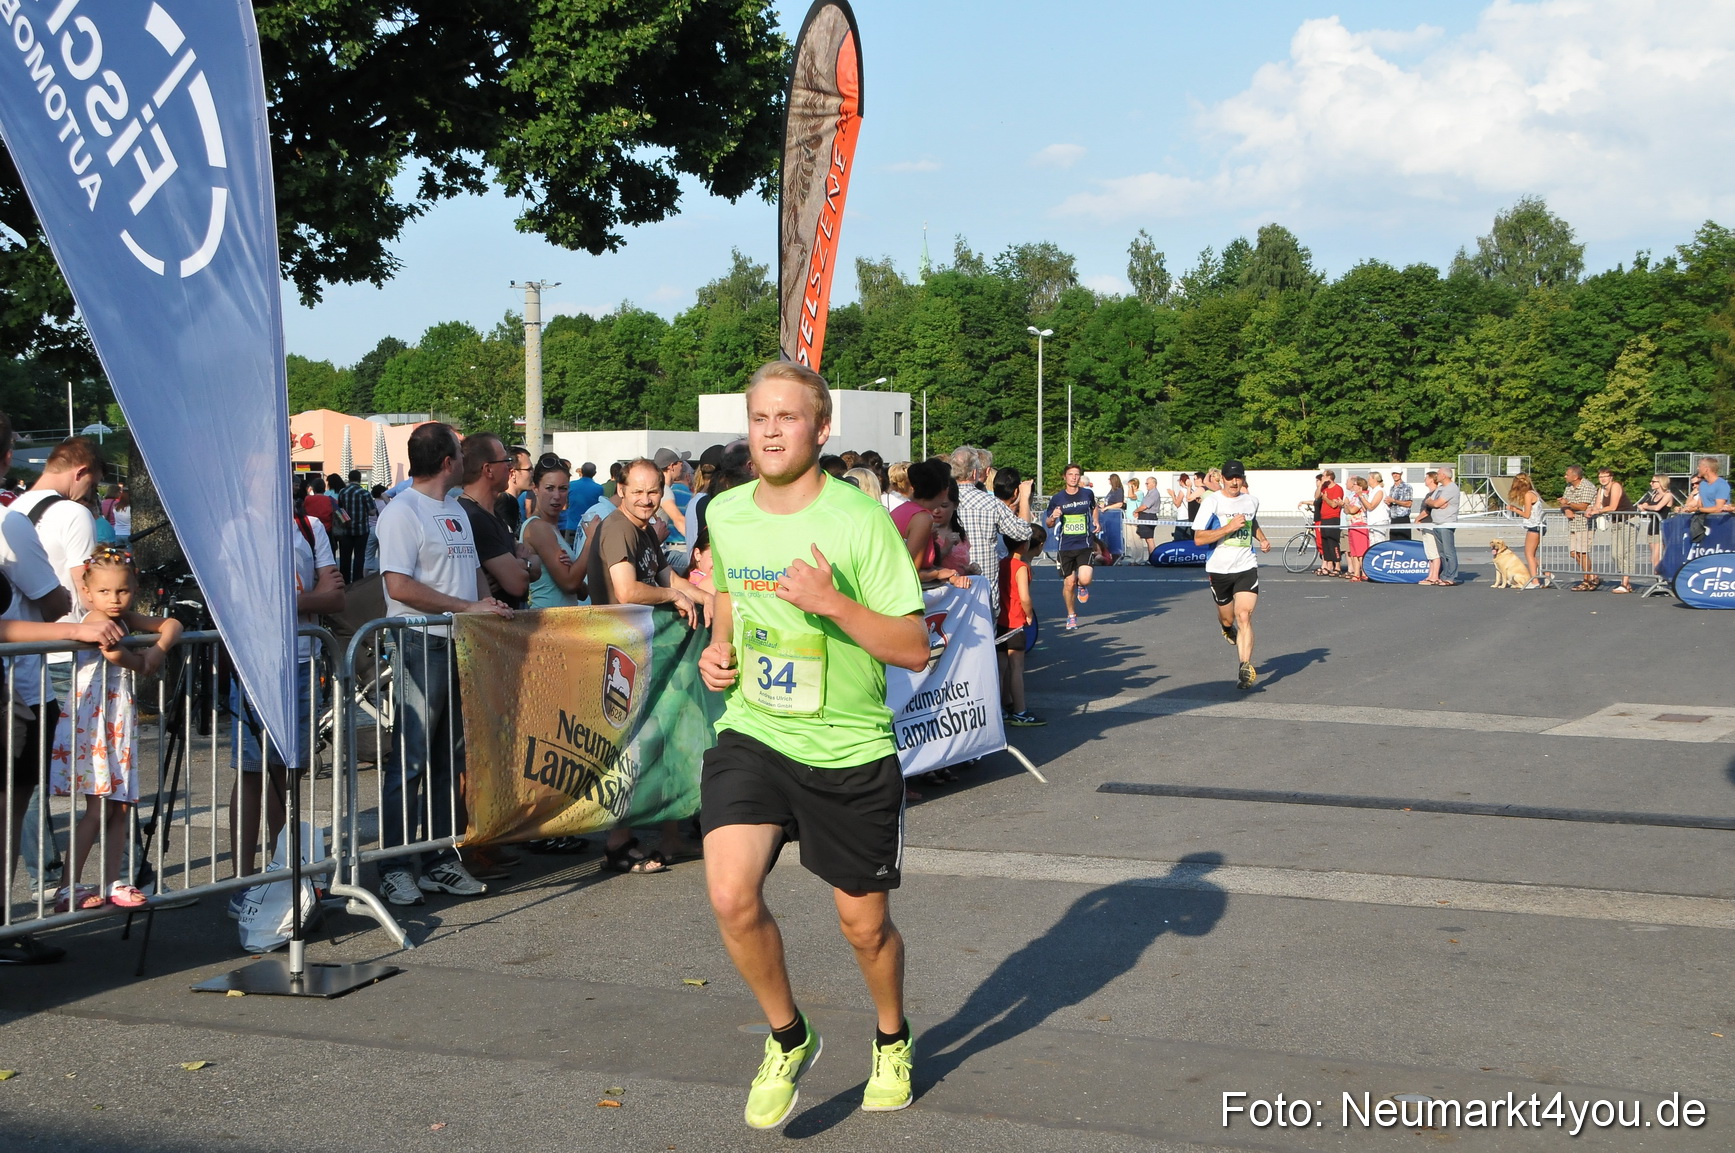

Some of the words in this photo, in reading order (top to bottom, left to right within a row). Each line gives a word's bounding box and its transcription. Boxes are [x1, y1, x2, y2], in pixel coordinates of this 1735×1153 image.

[1065, 523, 1084, 532] 5088
[757, 656, 797, 694] 34
[891, 702, 987, 752] Lammsbräu
